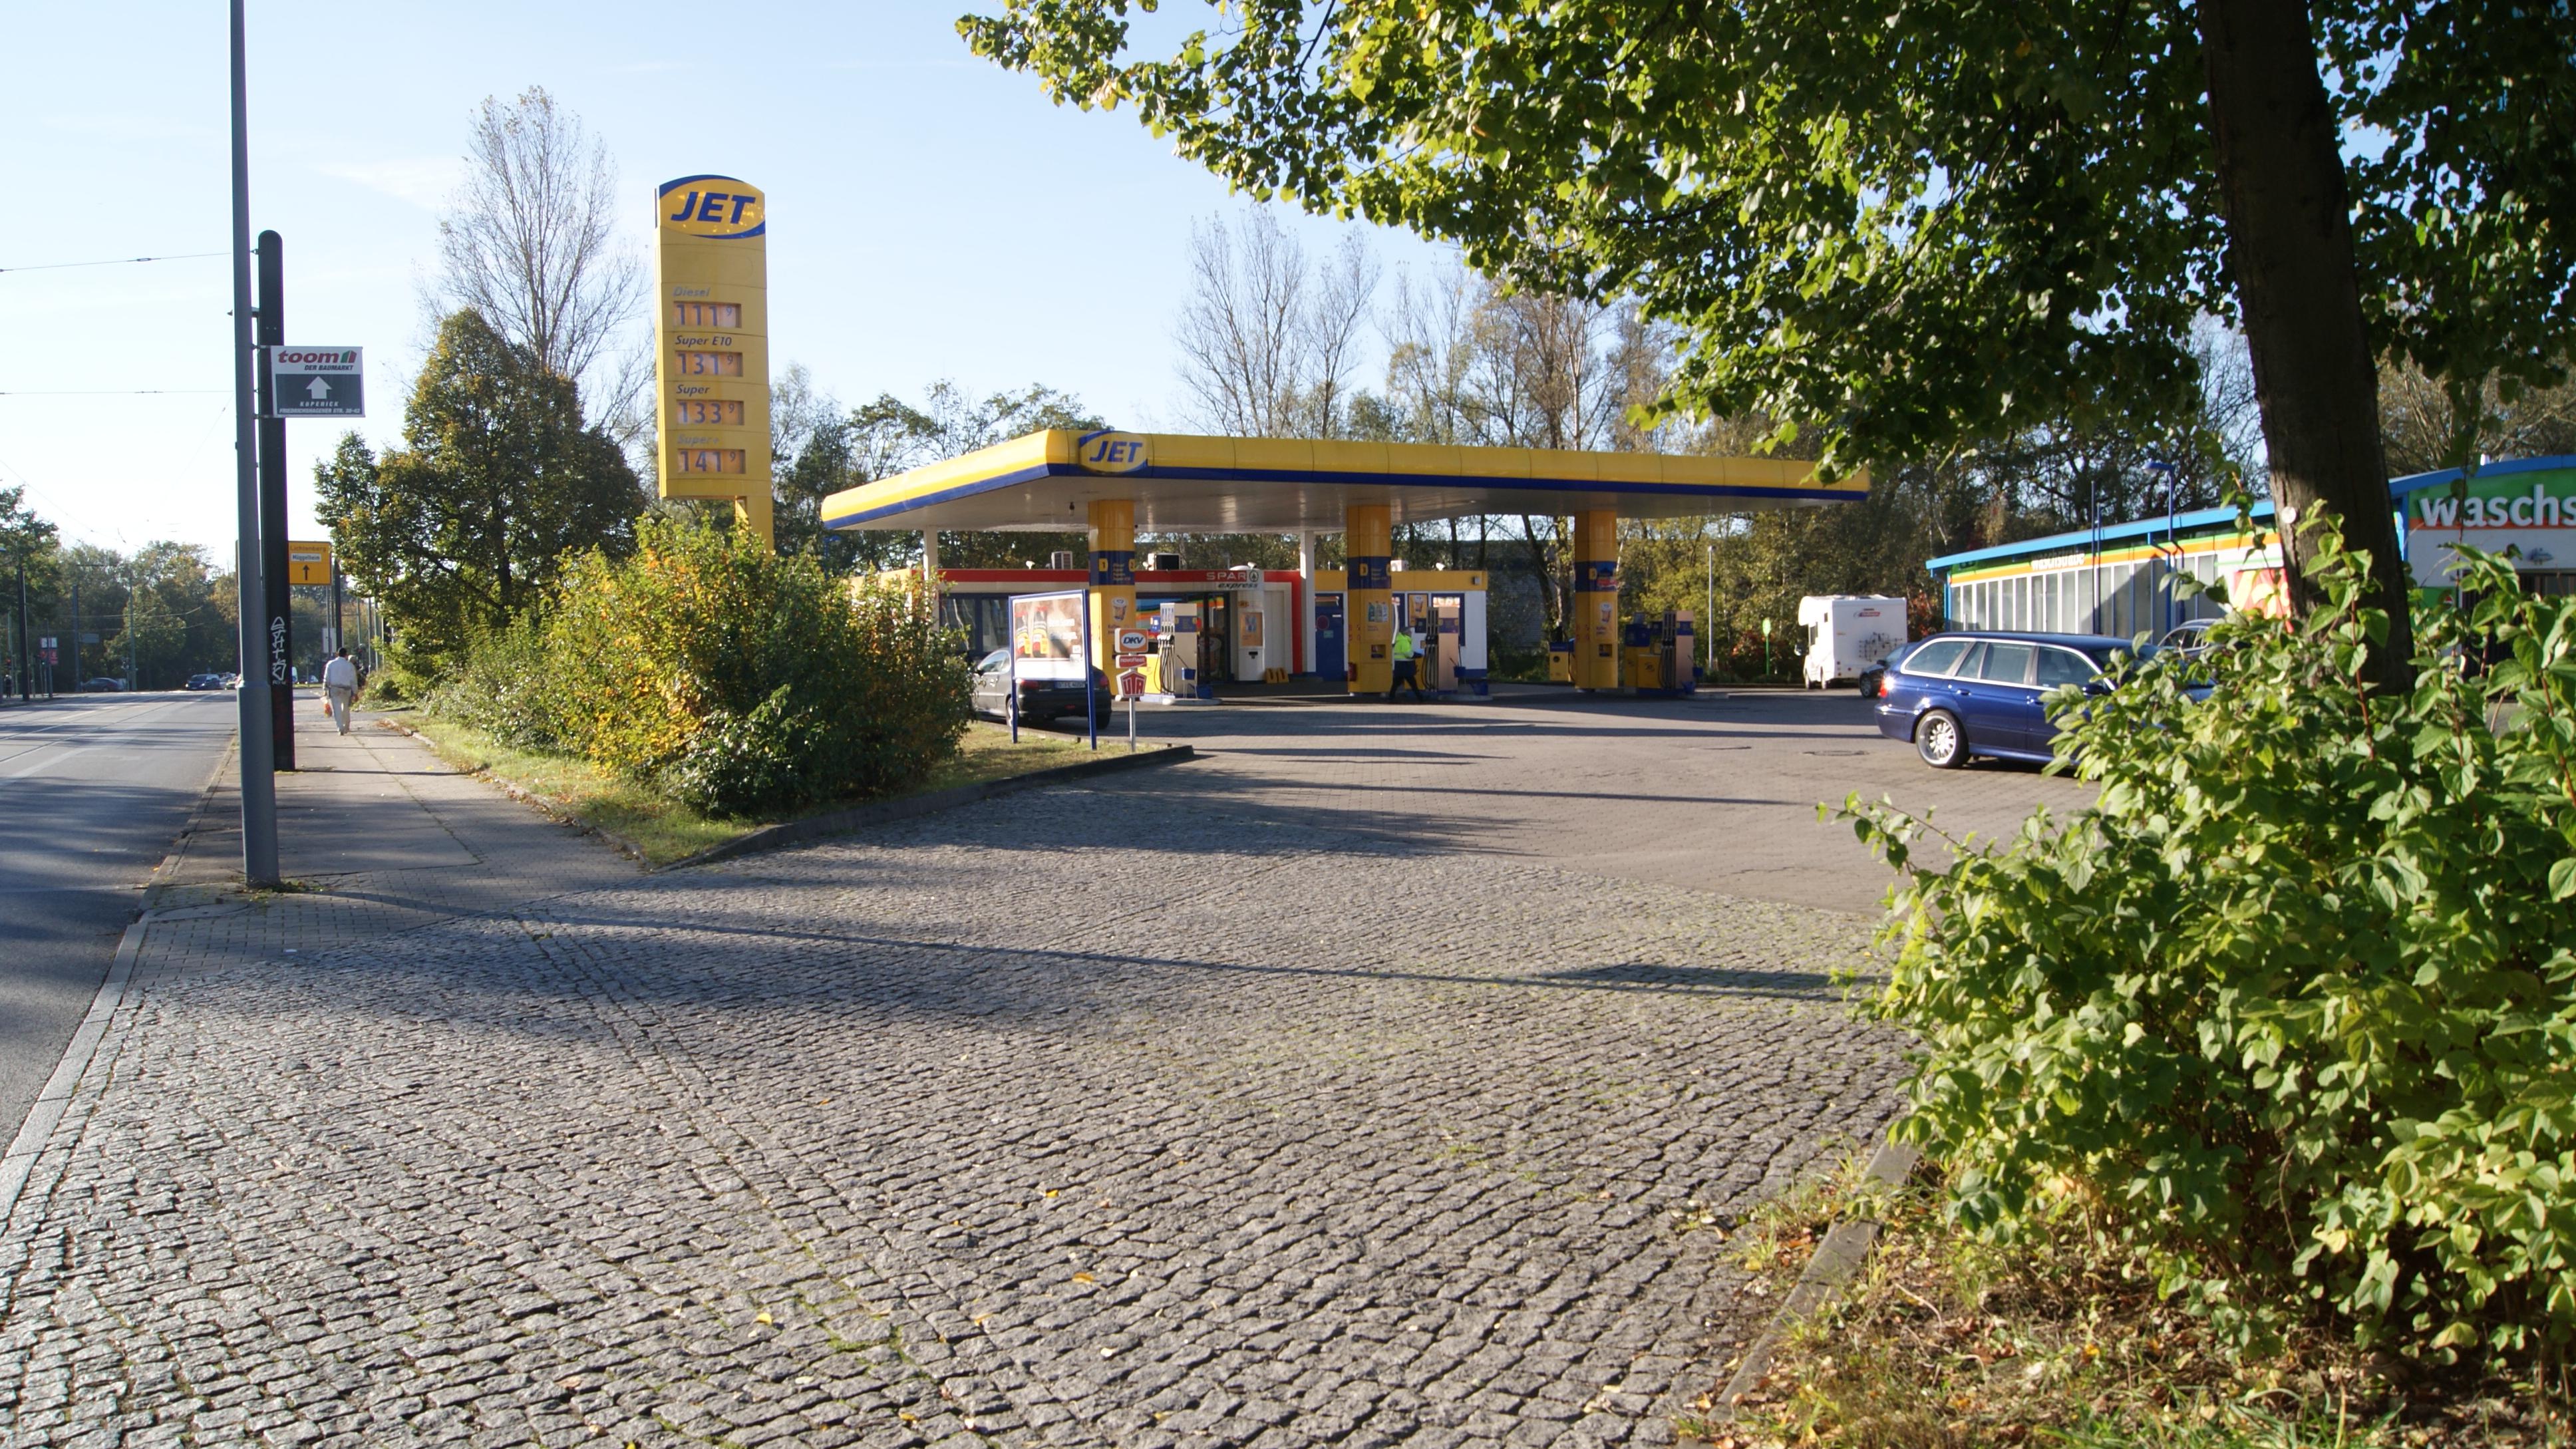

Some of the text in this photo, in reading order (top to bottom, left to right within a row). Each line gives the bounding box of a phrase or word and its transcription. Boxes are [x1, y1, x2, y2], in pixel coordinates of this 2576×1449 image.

[671, 191, 756, 224] JET
[673, 286, 711, 297] Diesel
[675, 335, 732, 349] Super E10
[277, 350, 340, 363] toom
[676, 384, 711, 397] Super
[1089, 440, 1143, 463] JET
[1206, 571, 1247, 581] SPAR
[1122, 673, 1145, 695] UTA
